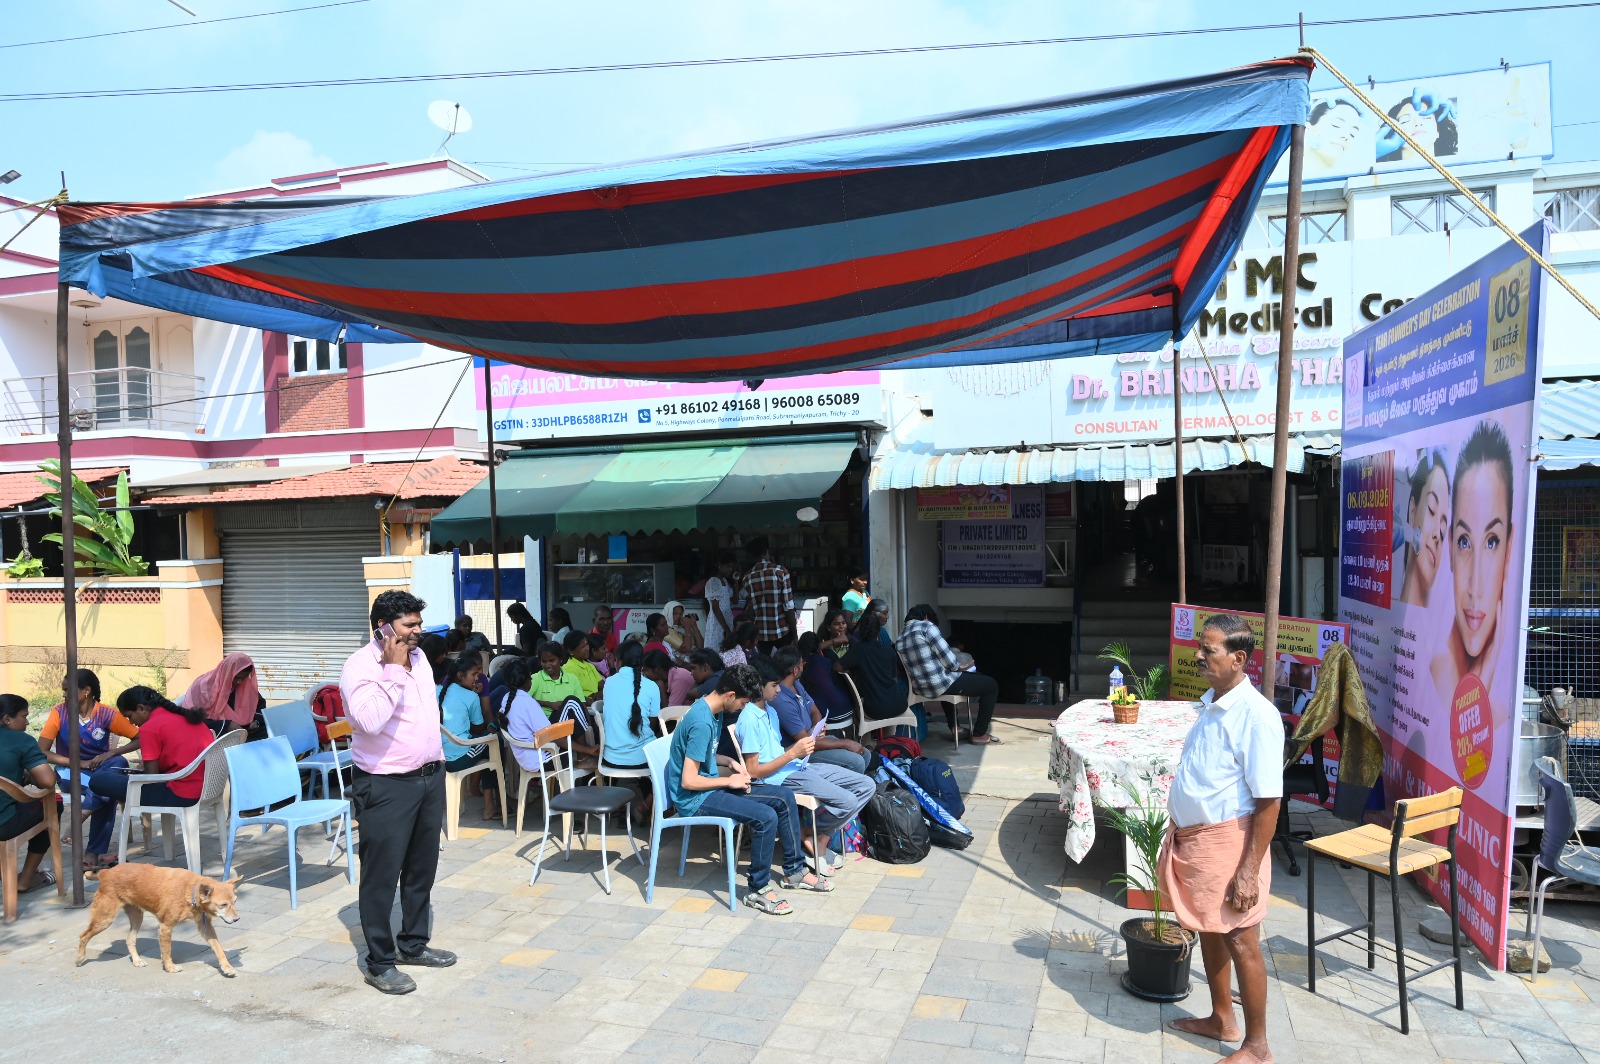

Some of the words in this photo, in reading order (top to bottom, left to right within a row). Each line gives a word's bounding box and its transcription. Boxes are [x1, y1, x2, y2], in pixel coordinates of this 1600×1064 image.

[1419, 306, 1432, 330] DAY
[1432, 277, 1481, 322] CELEBRATION
[1493, 352, 1516, 374] 2026
[1070, 374, 1109, 401] Dr.
[1120, 362, 1262, 398] BRINDHA
[1448, 369, 1479, 407] முகாம்
[655, 403, 678, 416] +91
[680, 400, 719, 415] 86102
[721, 398, 761, 412] 49168
[771, 395, 814, 409] 96008
[817, 392, 860, 407] 65089
[493, 418, 525, 431] GSTIN
[531, 412, 628, 429] 33DHLPB6588R1ZH
[670, 418, 696, 428] Highways
[829, 409, 847, 418] Trichy
[1175, 410, 1304, 430] ERMATOLOGST
[1311, 410, 1321, 422] &
[959, 525, 993, 541] PRIVATE
[994, 525, 1028, 541] LIMITED
[1278, 624, 1311, 634] EBRATION
[1322, 629, 1340, 643] 08
[1458, 704, 1481, 735] OFFER
[1405, 769, 1415, 797] &
[1455, 811, 1502, 870] LINIC
[1440, 879, 1451, 900] +91
[1482, 887, 1496, 920] 168
